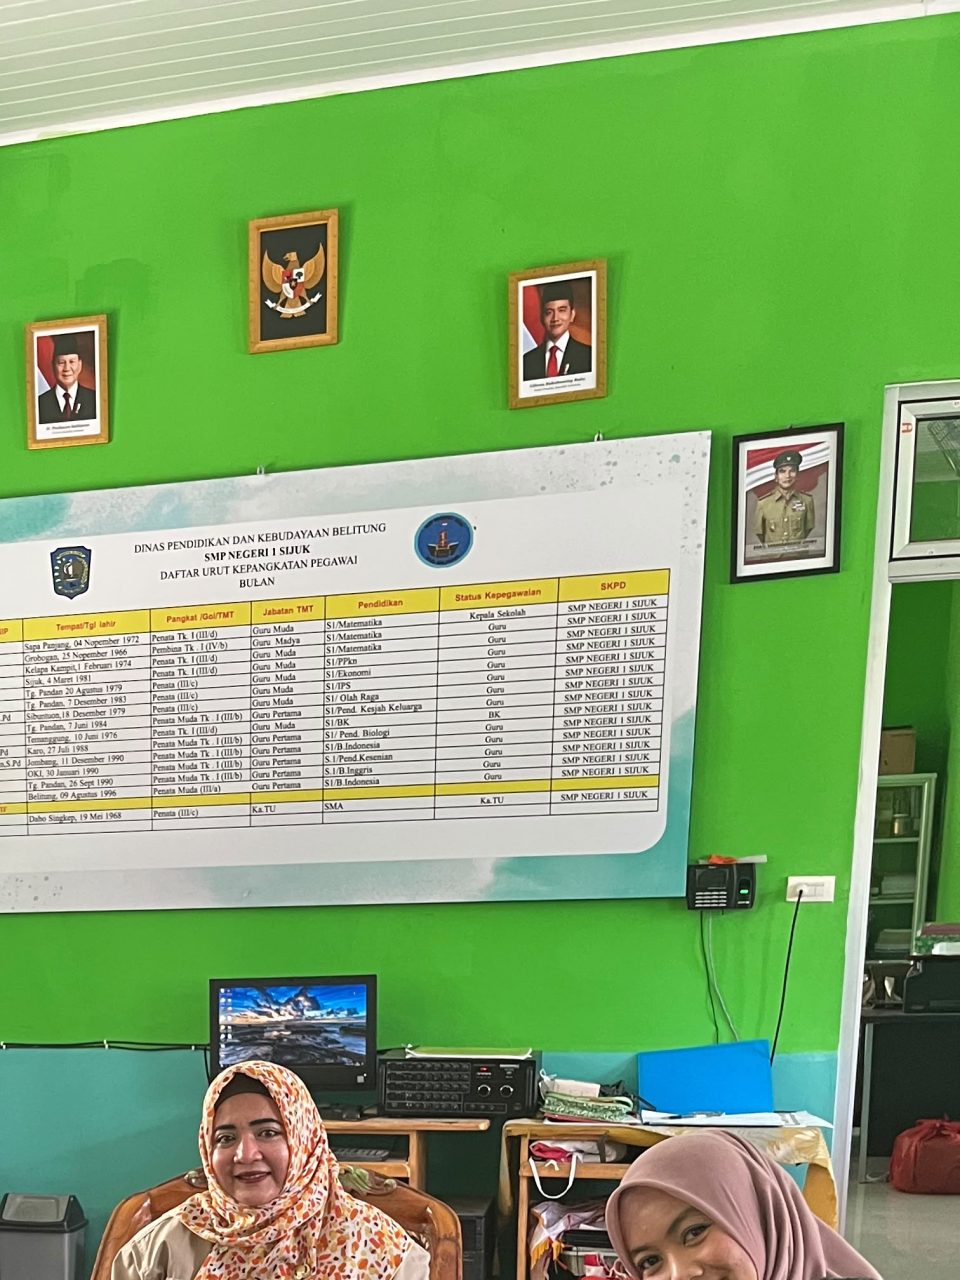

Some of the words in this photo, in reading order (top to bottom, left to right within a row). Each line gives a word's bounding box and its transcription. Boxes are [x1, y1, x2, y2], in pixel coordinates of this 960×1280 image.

[134, 542, 164, 553] DINAS
[167, 536, 229, 550] PENDIDIKAN
[232, 534, 254, 544] DAN
[257, 527, 329, 542] KEBUDAYAAN
[332, 522, 386, 536] BELITUNG
[204, 551, 226, 561] SMP
[228, 547, 268, 560] NEGERI
[272, 547, 275, 556] 1
[279, 544, 310, 556] SIJUK
[160, 568, 199, 580] DAFTAR
[202, 565, 230, 576] URUT
[232, 559, 307, 574] KEPANGKATAN
[310, 555, 357, 567] PEGAWAI
[239, 576, 274, 588] BULAN
[600, 580, 626, 590] SKPD
[455, 592, 481, 602] Status
[484, 587, 541, 601] Kepegawaian
[358, 598, 403, 609] Pendidikan
[567, 602, 586, 612] SMP
[588, 600, 622, 610] NEGERI
[631, 597, 657, 607] SIJUK
[263, 606, 293, 616] Jabatan
[296, 604, 313, 613] TMT
[469, 610, 494, 621] Kepala
[496, 608, 526, 618] Sekolah
[166, 613, 197, 624] Pangkat
[326, 617, 382, 630] S1/Matematika
[55, 620, 96, 633] Tempat/Tgl
[99, 619, 116, 628] lahir
[252, 625, 271, 634] Guru
[273, 624, 294, 633] Muda
[487, 622, 507, 631] Guru
[252, 638, 271, 647] Guru
[275, 636, 300, 646] Madya
[326, 630, 382, 642] S1/Matematika
[487, 635, 506, 644] Guru
[326, 642, 382, 654] S1/Matematika
[487, 647, 506, 656] Guru
[326, 656, 357, 667] S1/PPkn
[326, 668, 371, 679] S1/Ekonomi
[326, 681, 351, 691] S1/IPS
[326, 694, 338, 703] S1/
[339, 693, 358, 702] Olah
[360, 692, 379, 702] Raga
[485, 697, 504, 706] Guru
[326, 705, 357, 715] S1/Pend.
[388, 701, 422, 713] Keluarga
[252, 710, 270, 719] Guru
[272, 709, 301, 718] Pertama
[488, 710, 501, 719] BK
[325, 718, 349, 727] S1/BK
[325, 730, 337, 739] S1/
[339, 729, 359, 738] Pend.
[362, 728, 390, 738] Biologi
[325, 740, 380, 751] S1/B.Indonesia
[325, 752, 393, 763] S.1/Pend.Kesenian
[482, 760, 501, 768] Guru
[325, 765, 373, 776] S.1/B.Inggris
[483, 772, 502, 780] Guru
[325, 777, 379, 787] S1/B.Indonesia
[324, 801, 343, 810] SMA
[480, 796, 504, 804] Ka.TU
[252, 804, 276, 813] Ka.TU
